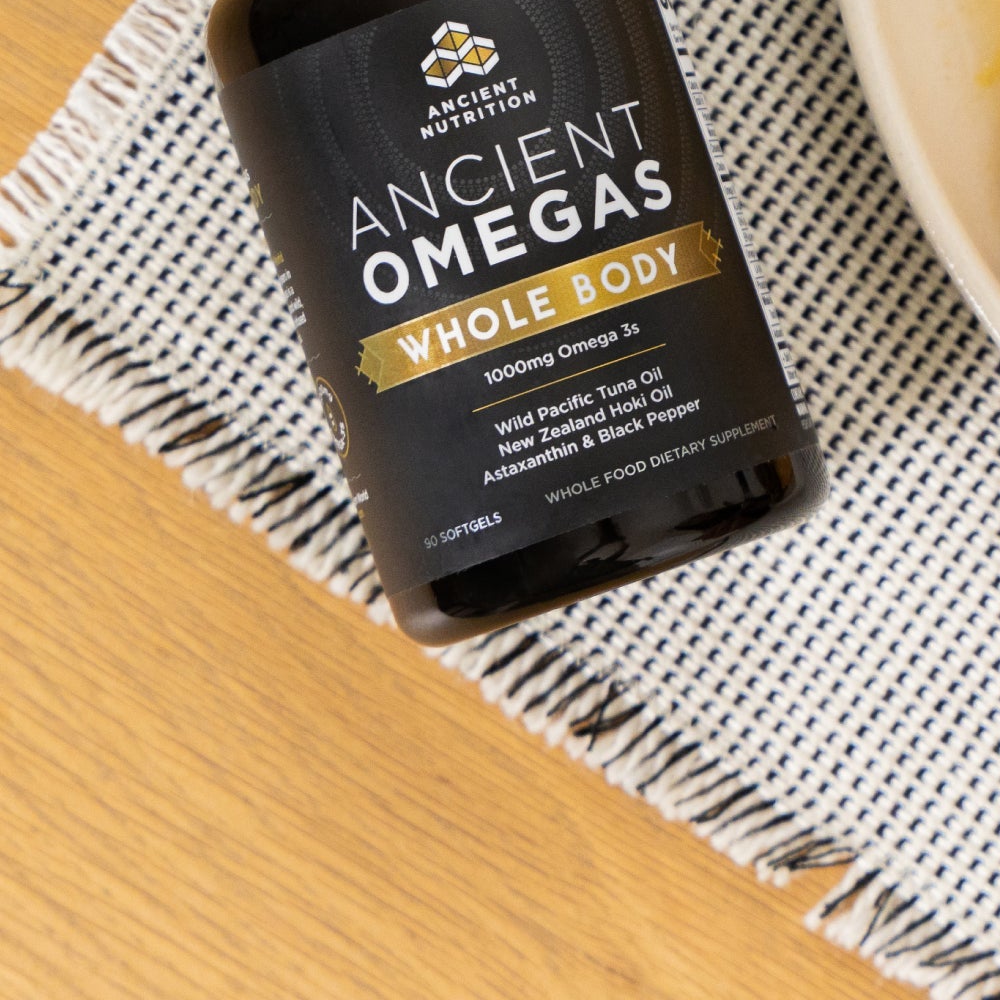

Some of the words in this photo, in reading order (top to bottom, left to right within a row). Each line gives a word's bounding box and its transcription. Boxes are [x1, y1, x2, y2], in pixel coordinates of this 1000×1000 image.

[421, 90, 536, 139] NUTRITION
[429, 78, 517, 119] ANCIENT
[353, 101, 645, 250] ANCIENT
[362, 160, 671, 304] OMEGAS
[397, 286, 556, 364] WHOLE
[571, 243, 677, 305] BODY
[484, 353, 554, 384] 1000mg
[558, 331, 618, 358] Omega
[621, 323, 639, 336] 3s
[495, 411, 534, 435] Wild
[538, 394, 593, 421] Pacific
[596, 379, 637, 399] Tuna
[641, 367, 662, 384] Oil
[499, 436, 534, 456] New
[539, 408, 606, 442] Zealand
[609, 394, 647, 417] Hoki
[651, 385, 673, 402] Oil
[485, 443, 578, 485] Astaxanthin
[583, 434, 595, 449] &
[598, 418, 643, 443] Black
[647, 399, 700, 427] Pepper
[545, 476, 601, 504] WHOLE
[604, 461, 646, 483] FOOD
[650, 439, 705, 470] DIETARY
[710, 414, 777, 447] SUPPLEMENT
[424, 535, 437, 548] 90
[440, 512, 502, 542] SOFTGELS
